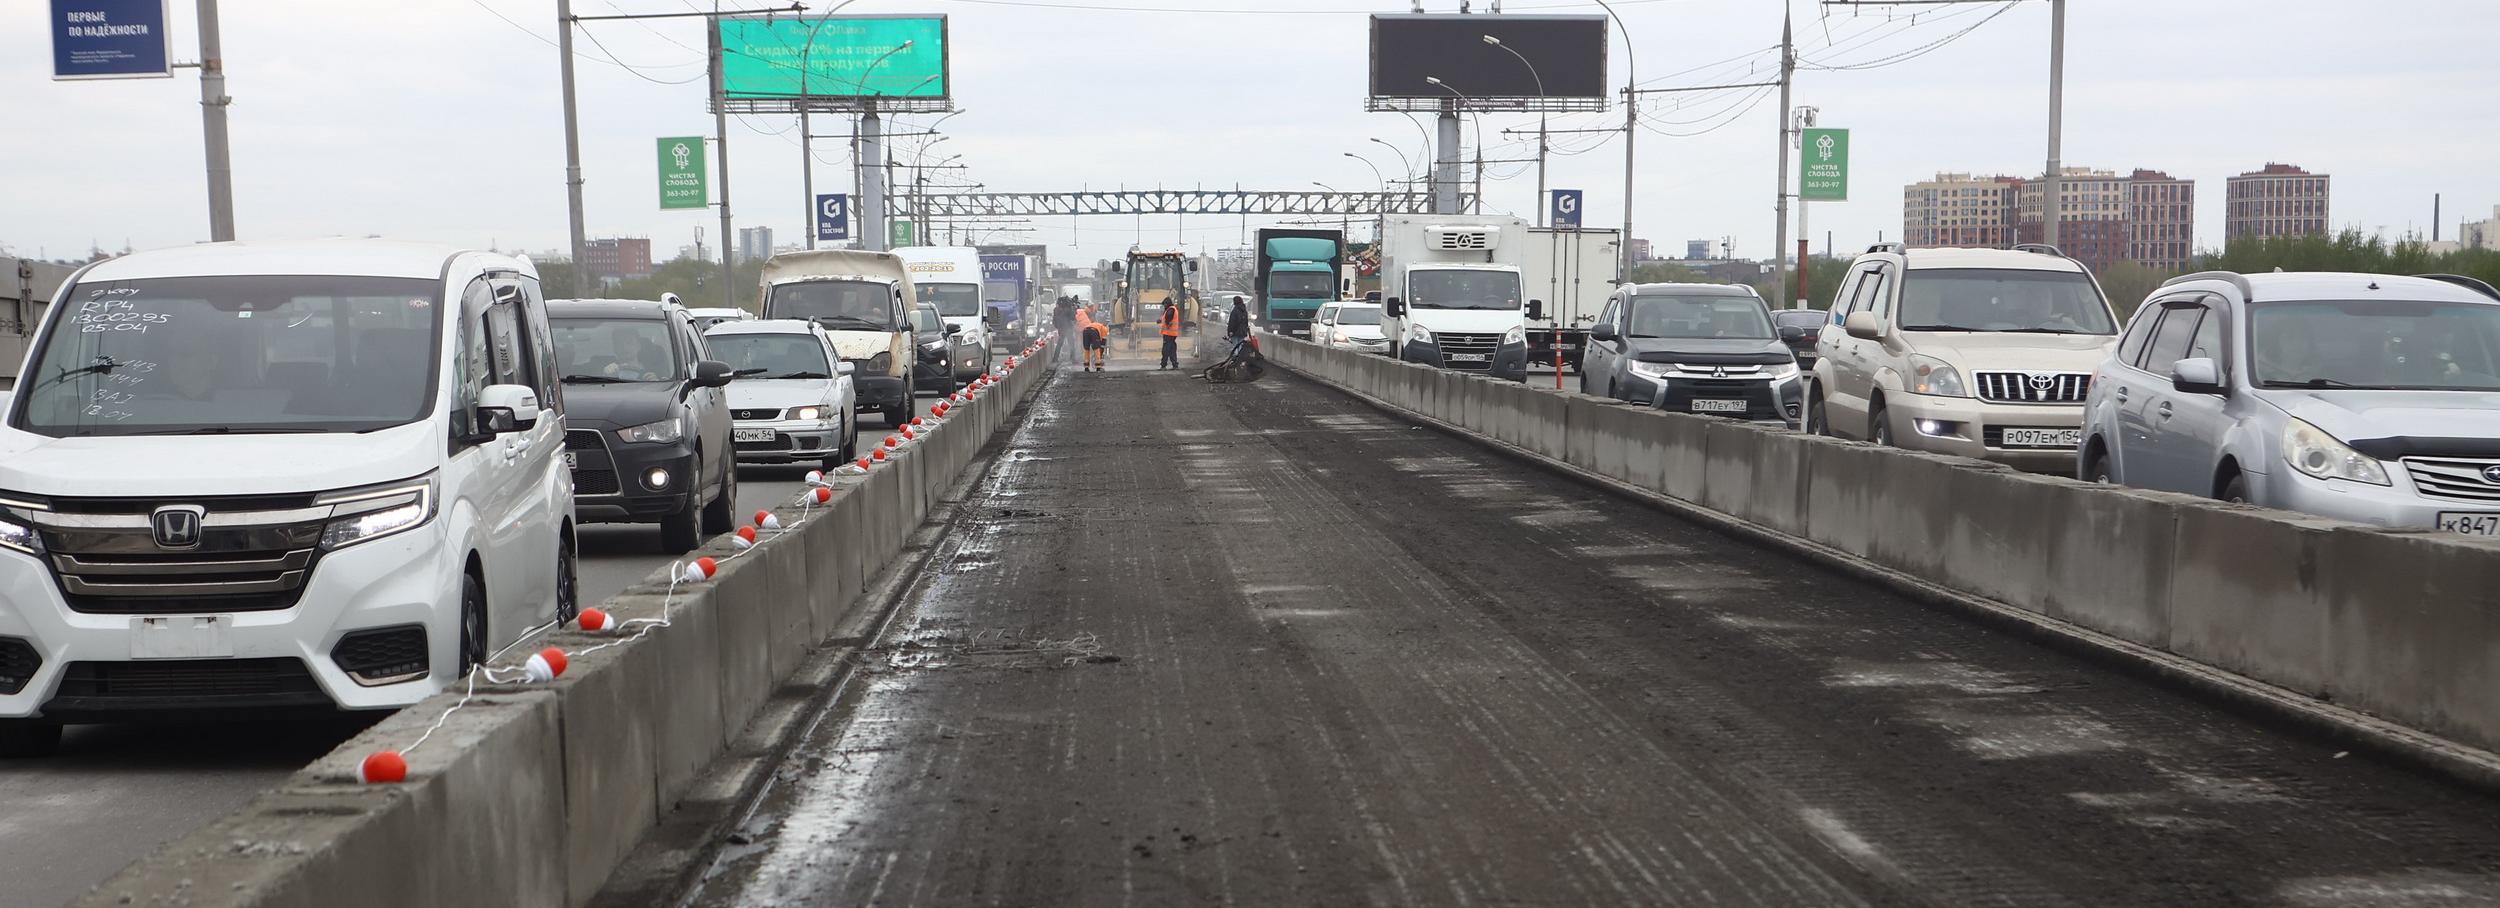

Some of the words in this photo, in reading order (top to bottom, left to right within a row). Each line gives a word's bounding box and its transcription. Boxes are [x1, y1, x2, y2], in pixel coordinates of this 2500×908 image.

[67, 11, 106, 22] ПЕРВЫЕ
[68, 26, 82, 37] ПО
[84, 23, 149, 38] НАДЁЖНОСТИ
[989, 261, 1019, 271] РОССИИ
[2007, 430, 2058, 443] Р097ЕМ
[2447, 516, 2499, 535] К847
